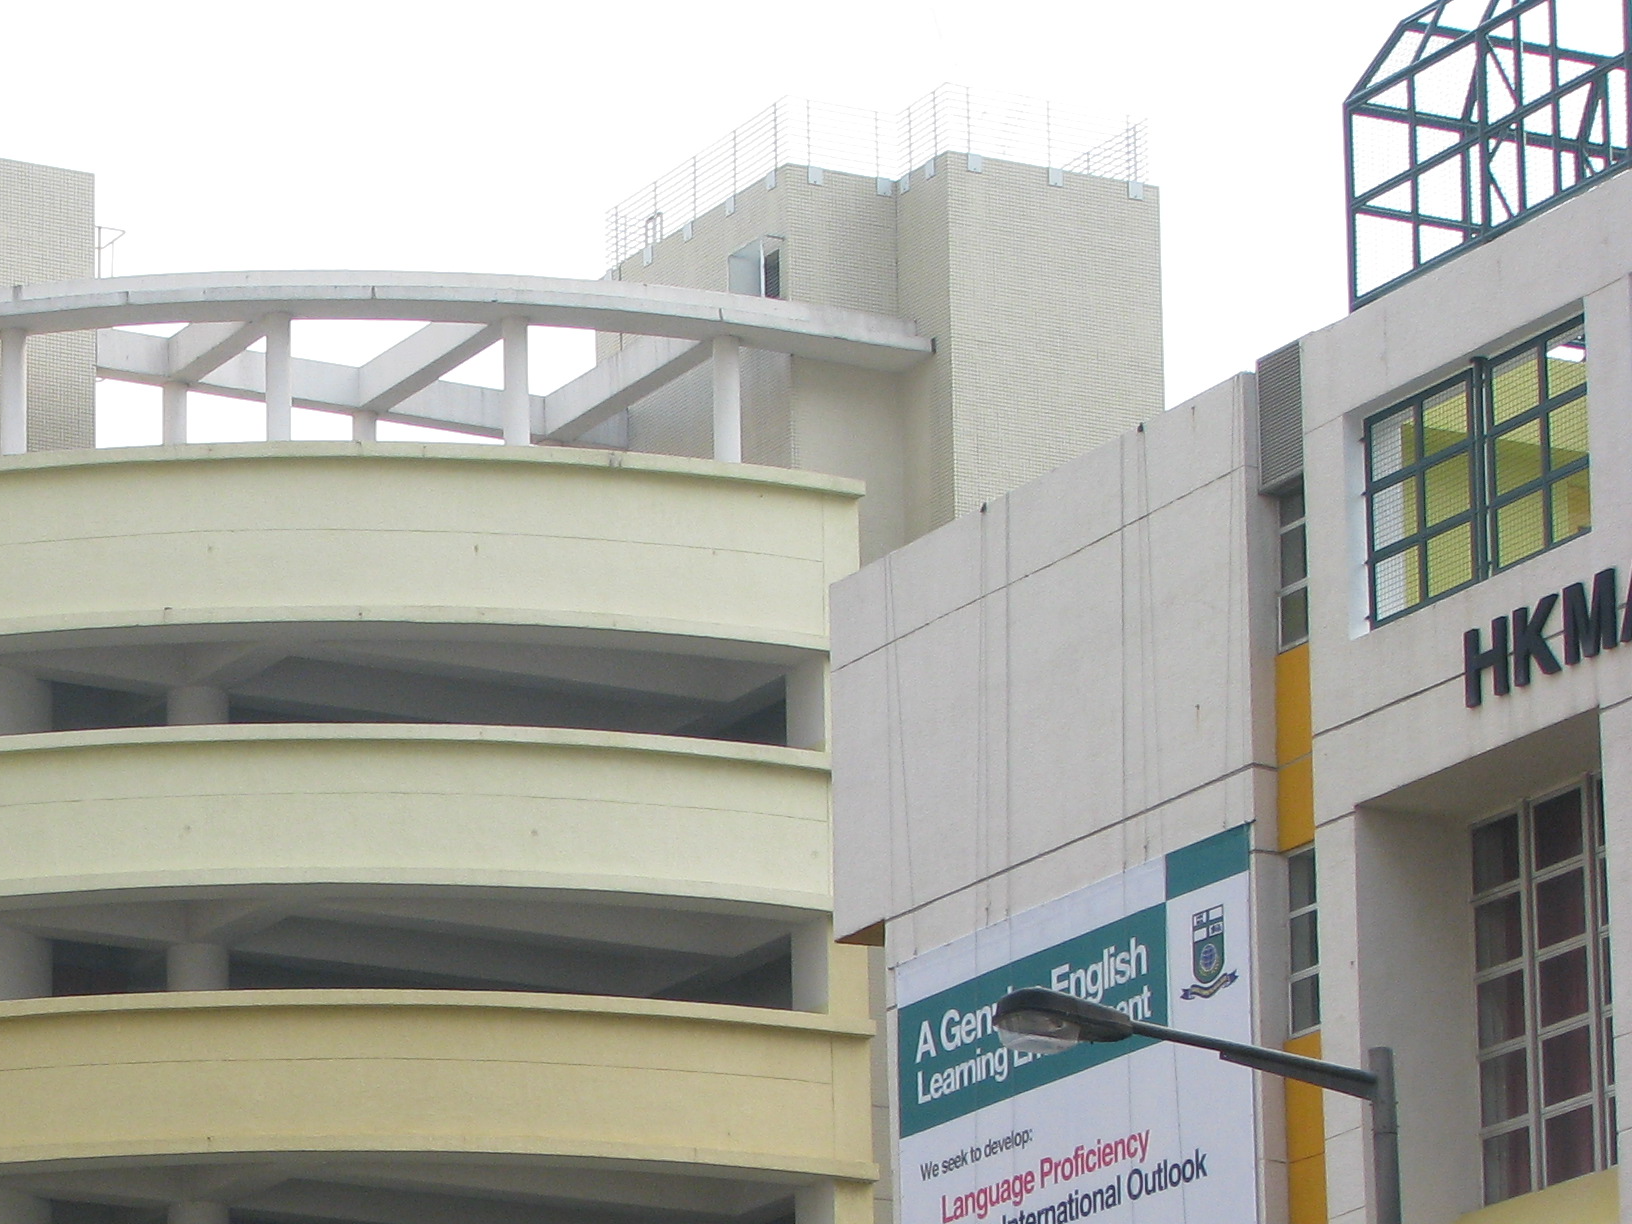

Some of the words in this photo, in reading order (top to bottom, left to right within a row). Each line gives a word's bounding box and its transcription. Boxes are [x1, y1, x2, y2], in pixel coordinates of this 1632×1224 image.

[1463, 567, 1632, 709] HKM
[916, 1020, 937, 1063] A
[1051, 937, 1149, 1004] English
[917, 1047, 1009, 1104] Learning
[920, 1161, 939, 1181] We
[941, 1150, 969, 1173] seek
[970, 1146, 981, 1163] to
[984, 1128, 1033, 1158] develop:
[941, 1170, 1035, 1224] Language
[1040, 1129, 1150, 1188] Proficiency
[1127, 1148, 1207, 1201] Outlook
